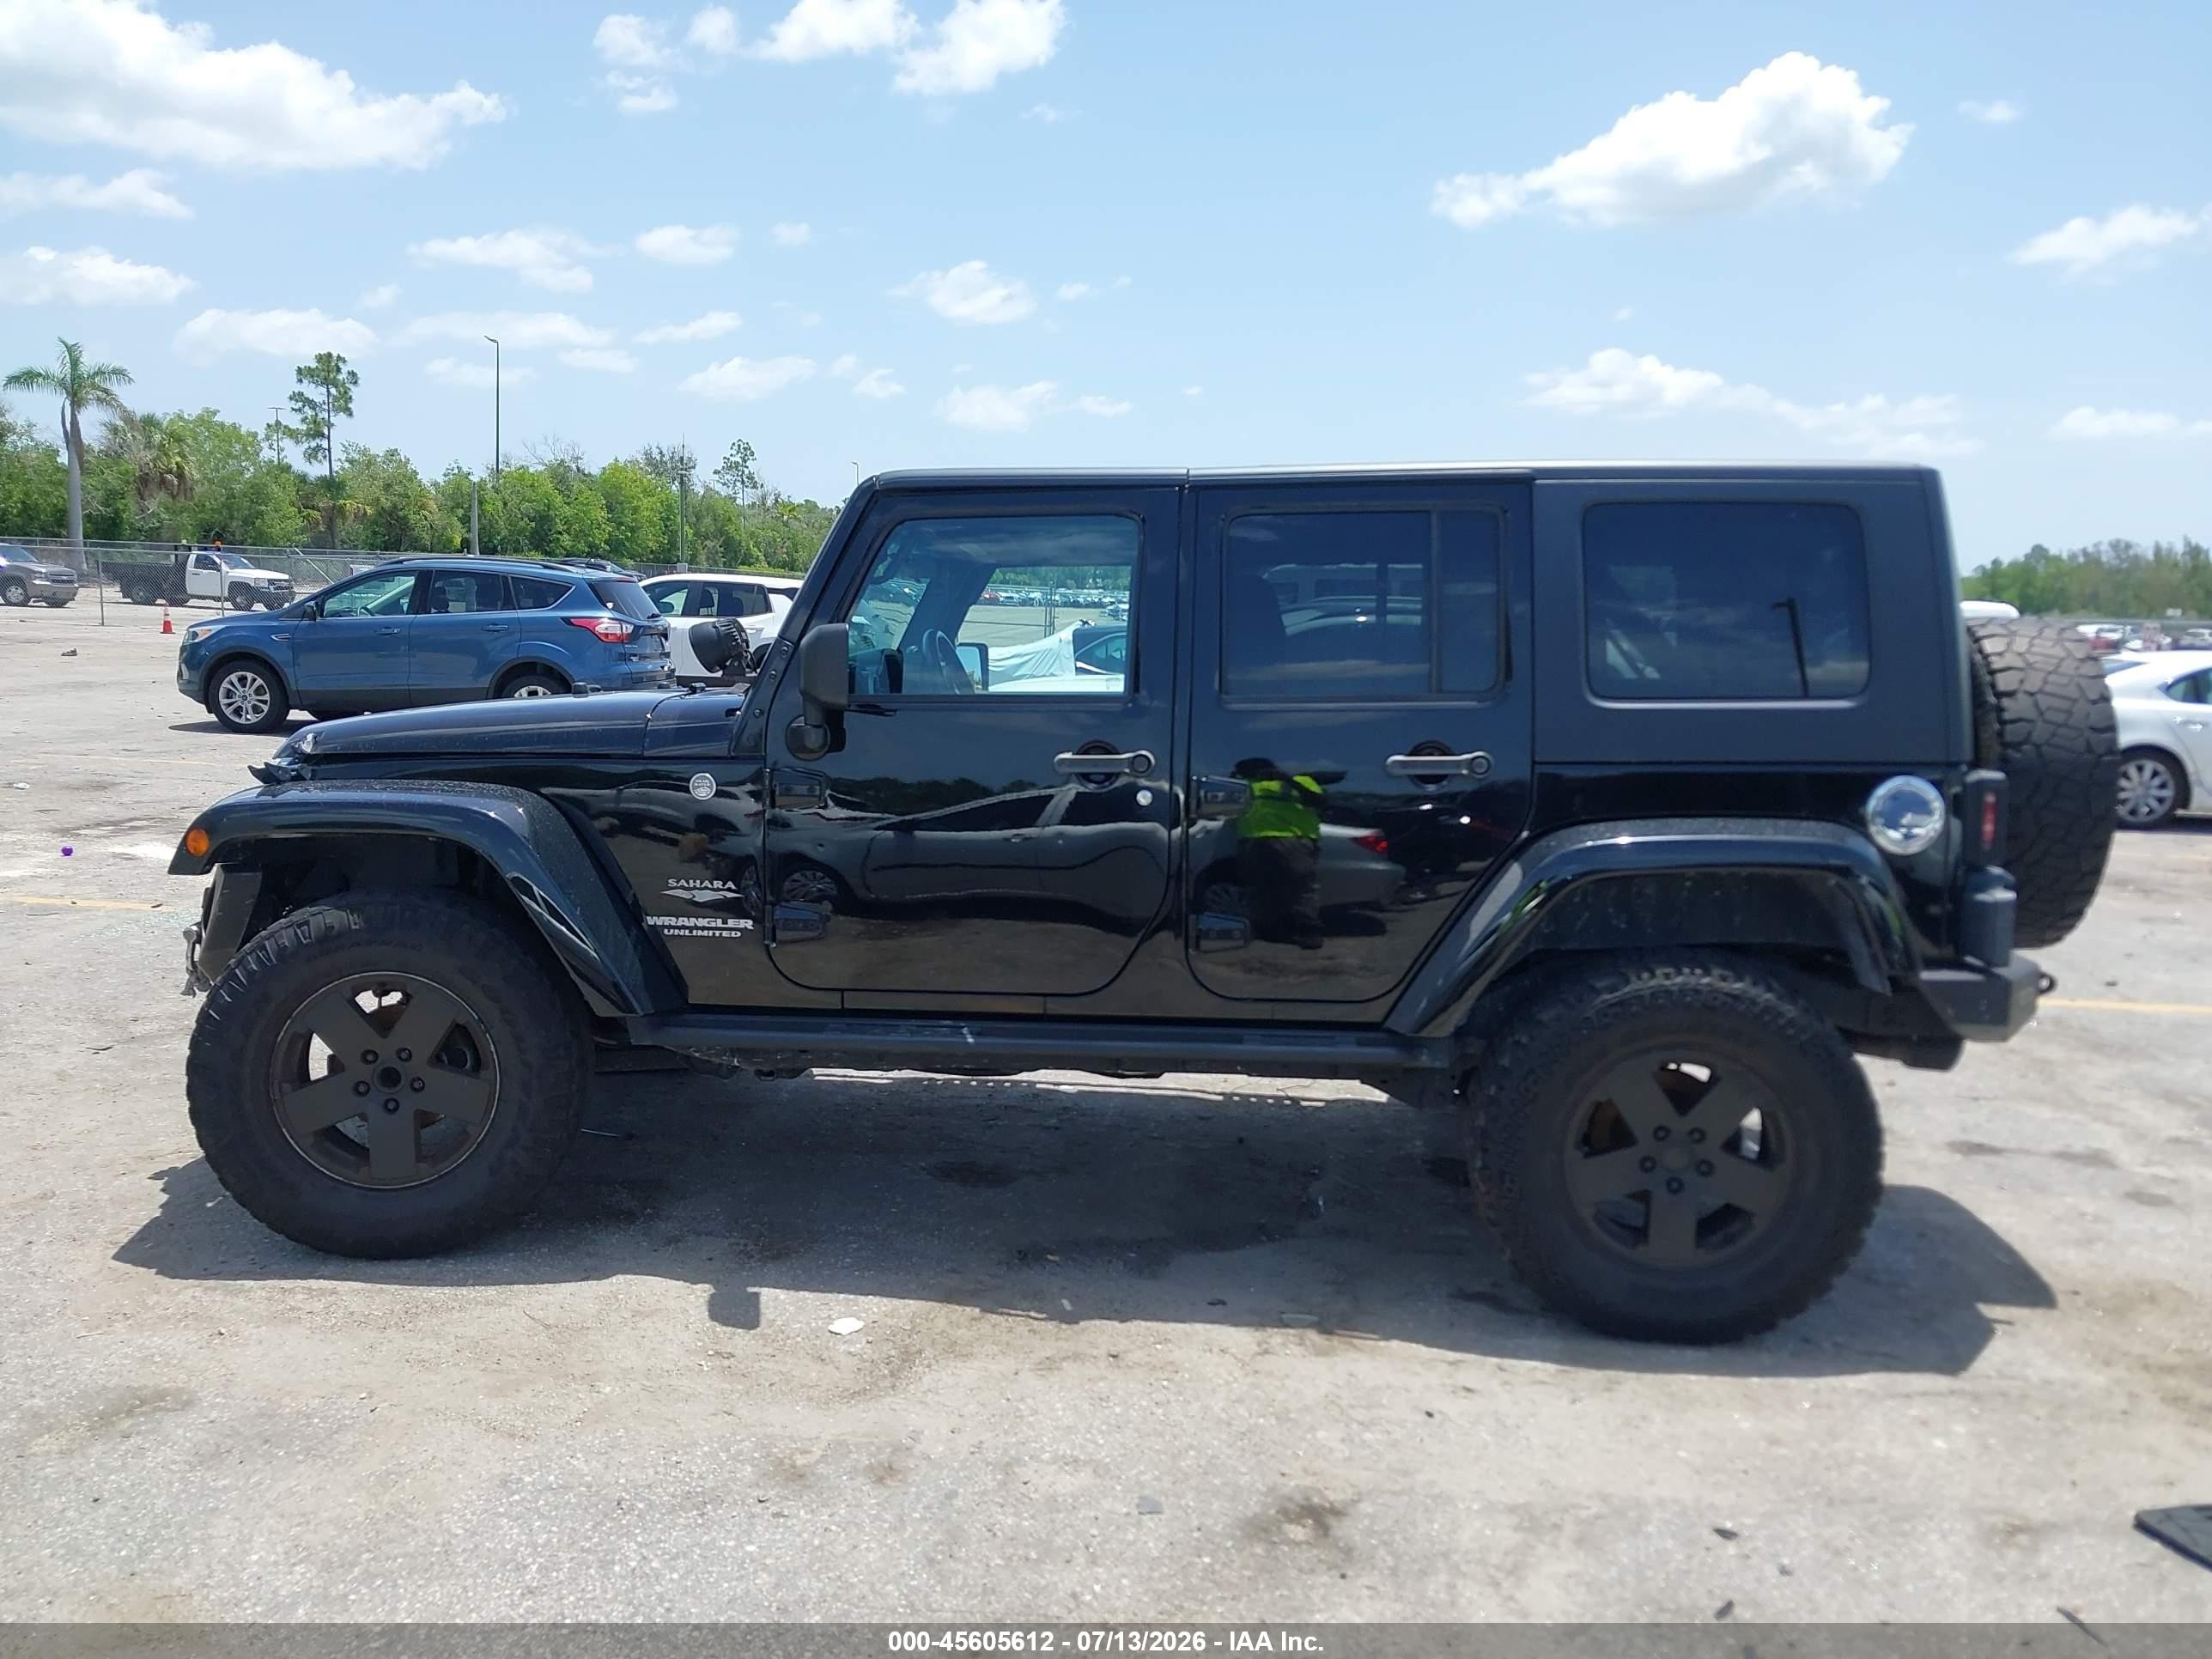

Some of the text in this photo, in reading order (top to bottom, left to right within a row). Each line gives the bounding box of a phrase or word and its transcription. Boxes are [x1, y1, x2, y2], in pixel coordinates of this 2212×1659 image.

[667, 878, 738, 890] SAHARA
[646, 915, 754, 929] WRANGLER
[664, 928, 742, 938] UNLIMITED
